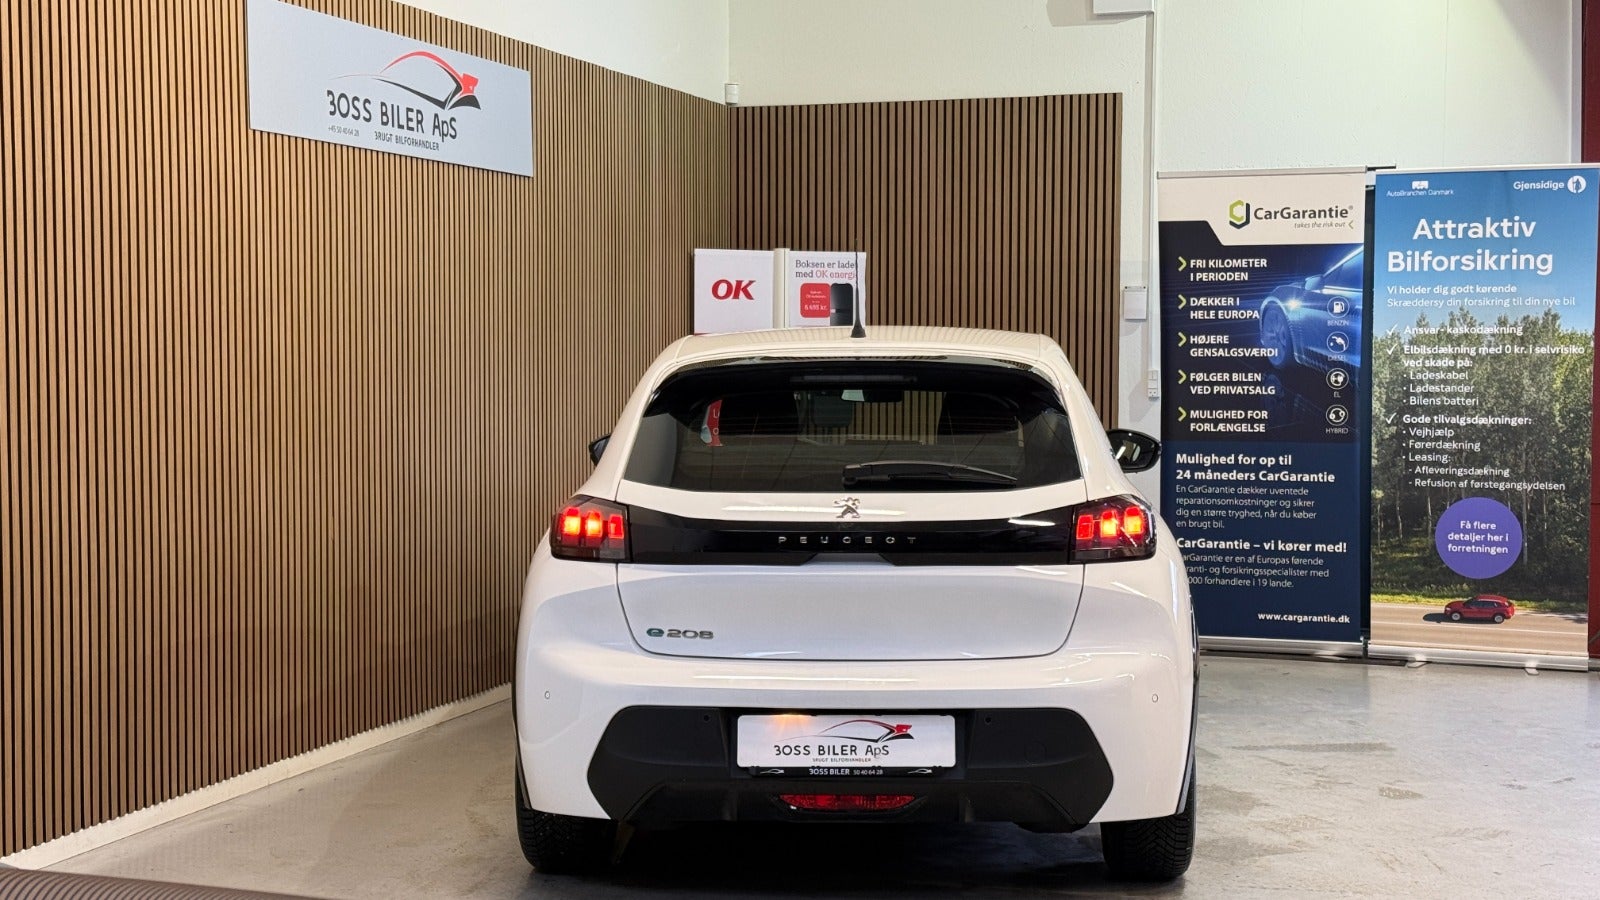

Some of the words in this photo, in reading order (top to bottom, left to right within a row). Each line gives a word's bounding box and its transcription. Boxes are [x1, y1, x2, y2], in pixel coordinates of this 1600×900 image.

[380, 102, 424, 133] BILER
[432, 113, 457, 142] ApS
[395, 135, 440, 151] BILFORHANDLER
[1514, 181, 1564, 192] Gjensidige
[1412, 216, 1536, 239] Attraktiv
[796, 260, 825, 268] Boksen
[837, 260, 856, 268] lade
[1190, 260, 1206, 268] FRI
[1208, 259, 1267, 268] KILOMETER
[1388, 248, 1553, 275] Bilforsikring
[796, 270, 813, 278] med
[816, 270, 828, 278] OK
[1196, 272, 1248, 281] PERIODEN
[712, 279, 756, 300] OK
[1387, 286, 1397, 294] Vi
[1400, 286, 1430, 294] holder
[1434, 285, 1448, 296] dig
[1451, 285, 1474, 296] godt
[1476, 285, 1517, 293] kørende
[1190, 298, 1234, 306] DÆKKER
[1387, 299, 1444, 308] Skræddersy
[1446, 298, 1462, 307] din
[1464, 297, 1510, 308] forsikring
[1512, 297, 1522, 306] til
[1525, 297, 1540, 306] din
[1543, 299, 1561, 308] nye
[1563, 297, 1575, 305] bil
[1190, 310, 1215, 319] HELE
[1218, 310, 1260, 319] EUROPA
[1403, 326, 1444, 334] Ansvar-
[1447, 325, 1523, 336] kaskodækning
[1190, 335, 1229, 344] HØJERE
[1190, 348, 1278, 357] GENSALGSVÆRDI
[1404, 346, 1476, 355] Elbilsdækning
[1478, 345, 1502, 354] med
[1505, 346, 1512, 354] 0
[1514, 345, 1527, 354] kr.
[1534, 345, 1585, 354] selvrisiko
[1403, 358, 1422, 367] ved
[1425, 359, 1455, 367] skade
[1457, 358, 1473, 368] på:
[1190, 372, 1229, 382] FØLGER
[1232, 373, 1261, 382] BILEN
[1410, 371, 1469, 380] Ladeskabel
[1190, 386, 1210, 395] VED
[1214, 386, 1275, 395] PRIVATSALG
[1410, 384, 1474, 393] Ladestander
[1410, 397, 1441, 405] Bilens
[1444, 397, 1479, 405] batteri
[1190, 410, 1245, 419] MULIGHED
[1247, 410, 1268, 419] FOR
[1403, 415, 1431, 424] Gode
[1433, 415, 1532, 426] tilvalgsdækninger:
[1190, 424, 1266, 432] FORLÆNGELSE
[1409, 427, 1454, 438] Vejhjælp
[1409, 440, 1480, 451] Førerdækning
[1176, 454, 1234, 466] Mulighed
[1238, 454, 1256, 465] for
[1259, 458, 1275, 467] op
[1278, 455, 1292, 465] til
[1176, 470, 1191, 480] 24
[1194, 469, 1256, 481] måneders
[1259, 471, 1335, 482] CarGarantie
[1415, 466, 1510, 477] Afleveringsdækning
[1176, 485, 1186, 493] En
[1188, 485, 1235, 494] CarGarantie
[1237, 486, 1267, 495] dækker
[1270, 487, 1309, 496] uventede
[1414, 479, 1456, 488] Refusion
[1458, 480, 1468, 488] af
[1470, 480, 1566, 492] førstegangsydelsen
[1176, 497, 1276, 508] reparationsomkostninger
[1279, 500, 1290, 508] og
[1292, 499, 1315, 507] sikrer
[1176, 509, 1189, 518] dig
[1203, 509, 1226, 517] større
[1228, 509, 1263, 519] tryghed,
[1265, 509, 1278, 518] når
[1279, 510, 1290, 518] du
[1293, 510, 1317, 519] køber
[1188, 520, 1211, 530] brugt
[1213, 520, 1224, 528] bil.
[1460, 520, 1471, 529] Få
[1474, 521, 1496, 530] flere
[778, 536, 916, 544] PEUGEOT
[1448, 532, 1485, 543] detaljer
[1488, 533, 1503, 541] her
[1177, 538, 1250, 549] CarGarantie
[1263, 540, 1274, 550] vi
[1278, 540, 1311, 551] kører
[1315, 542, 1347, 553] med!
[1448, 544, 1509, 555] forretningen
[1183, 554, 1223, 562] arGarantie
[1248, 555, 1255, 563] af
[1257, 556, 1290, 565] Europas
[1292, 556, 1324, 565] førende
[1222, 566, 1308, 577] forsikringsspecialister
[1310, 569, 1329, 577] med
[1188, 576, 1202, 584] 000
[1204, 576, 1250, 586] forhandlere
[1270, 580, 1294, 588] lande.
[1258, 613, 1350, 623] www.cargarantie.dk
[818, 745, 857, 756] BILER
[865, 745, 890, 758] ApS
